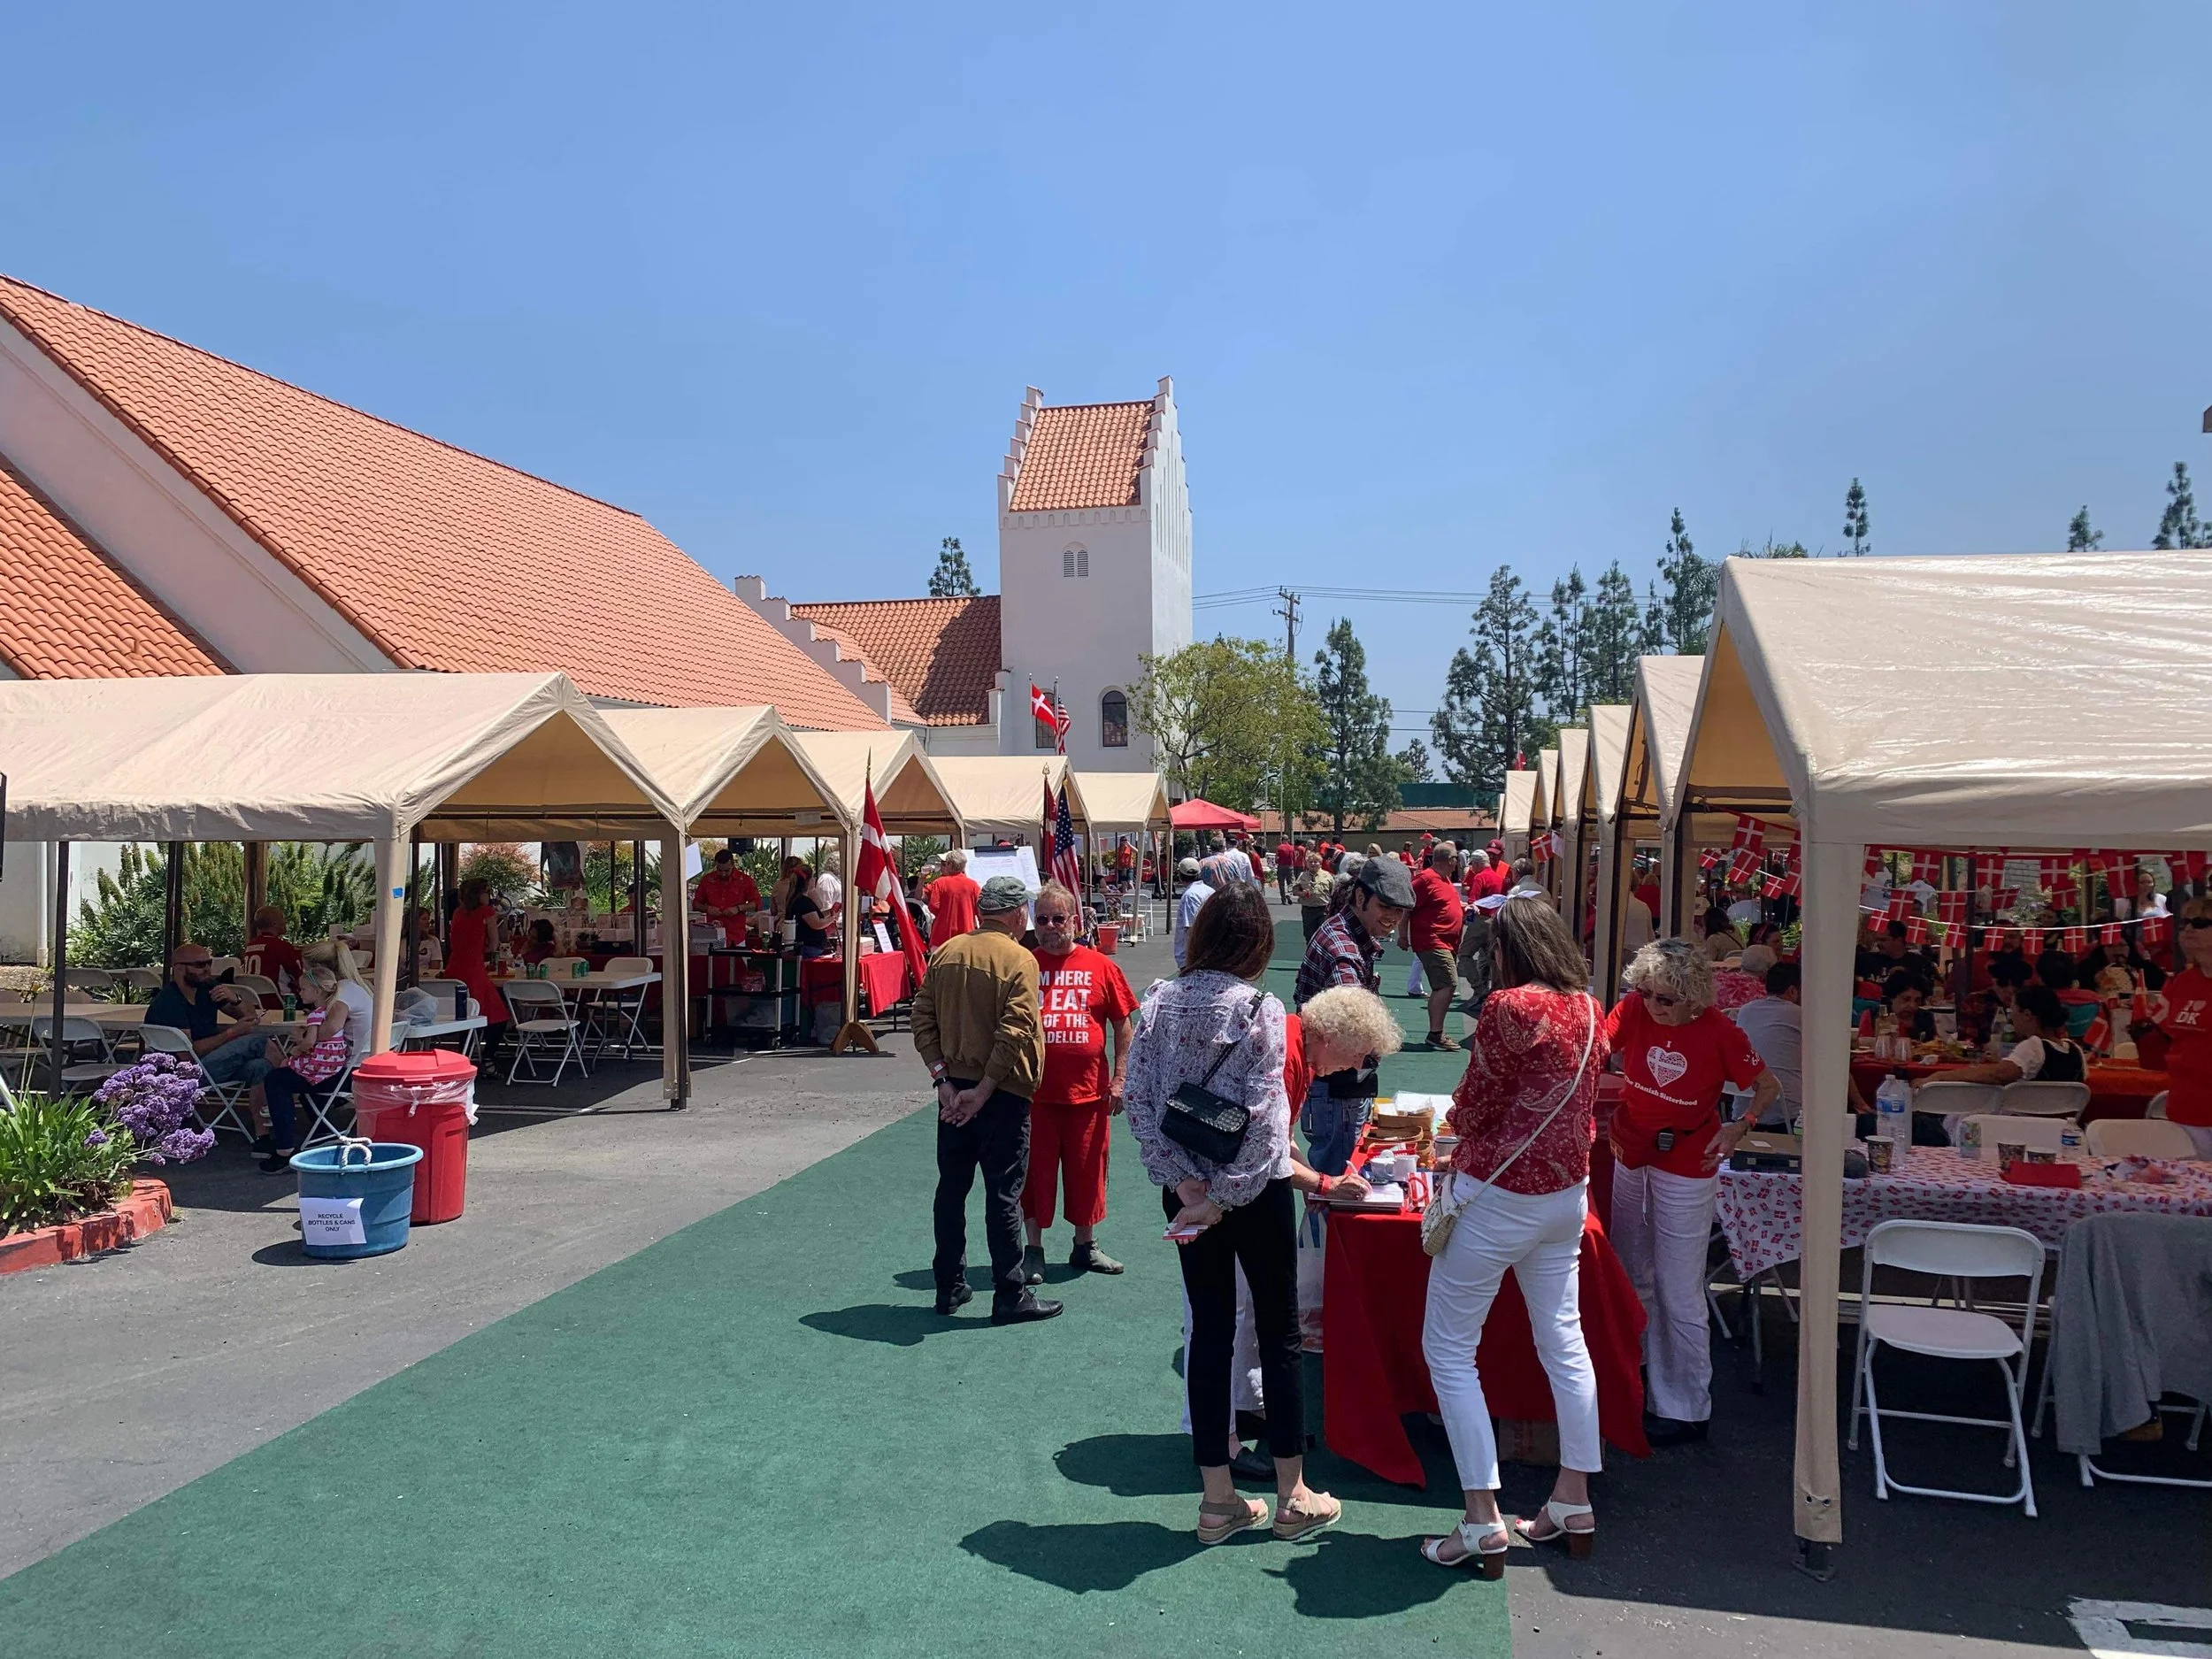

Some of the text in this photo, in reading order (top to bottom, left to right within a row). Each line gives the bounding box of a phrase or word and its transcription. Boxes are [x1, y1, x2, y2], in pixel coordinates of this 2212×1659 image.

[1054, 971, 1093, 987] HERE
[1050, 988, 1092, 1010] EAT
[1043, 1013, 1089, 1028] OF THE
[2176, 1011, 2200, 1025] DK
[1624, 1075, 1698, 1107] The Danish Sisterhood
